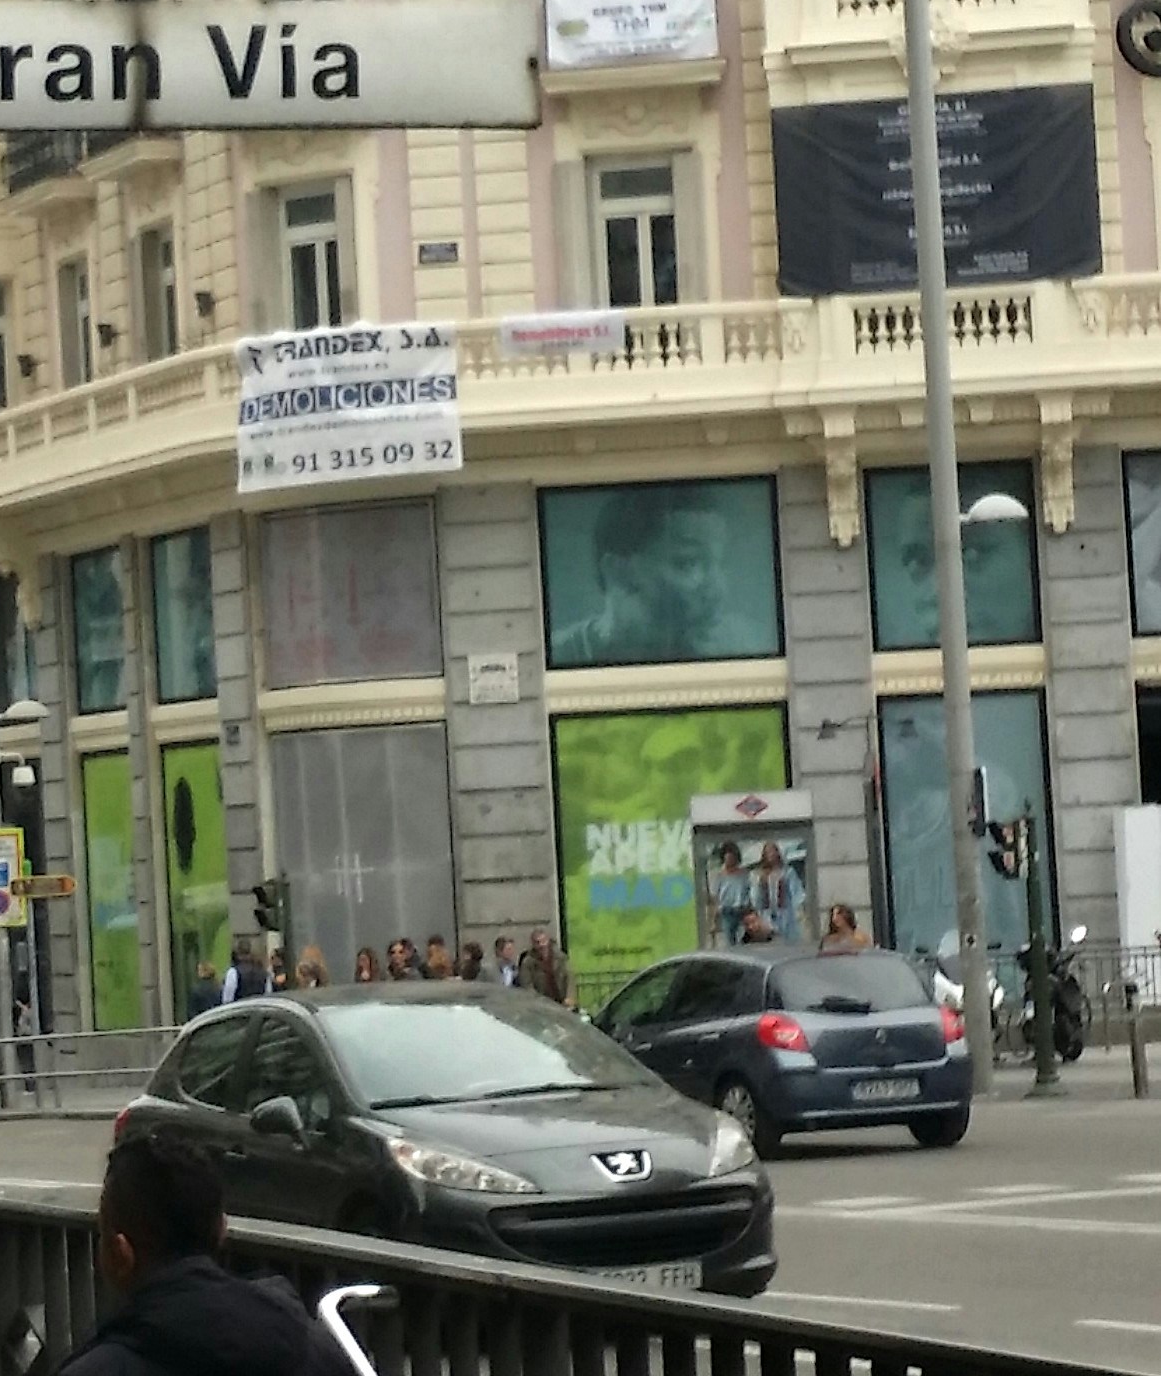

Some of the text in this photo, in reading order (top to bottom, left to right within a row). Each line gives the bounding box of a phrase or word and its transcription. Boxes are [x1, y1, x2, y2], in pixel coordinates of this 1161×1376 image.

[207, 24, 361, 101] Vía
[242, 376, 453, 423] DEMOLICIONES
[292, 439, 453, 474] 91 315 09 32
[660, 1266, 695, 1286] FFH
